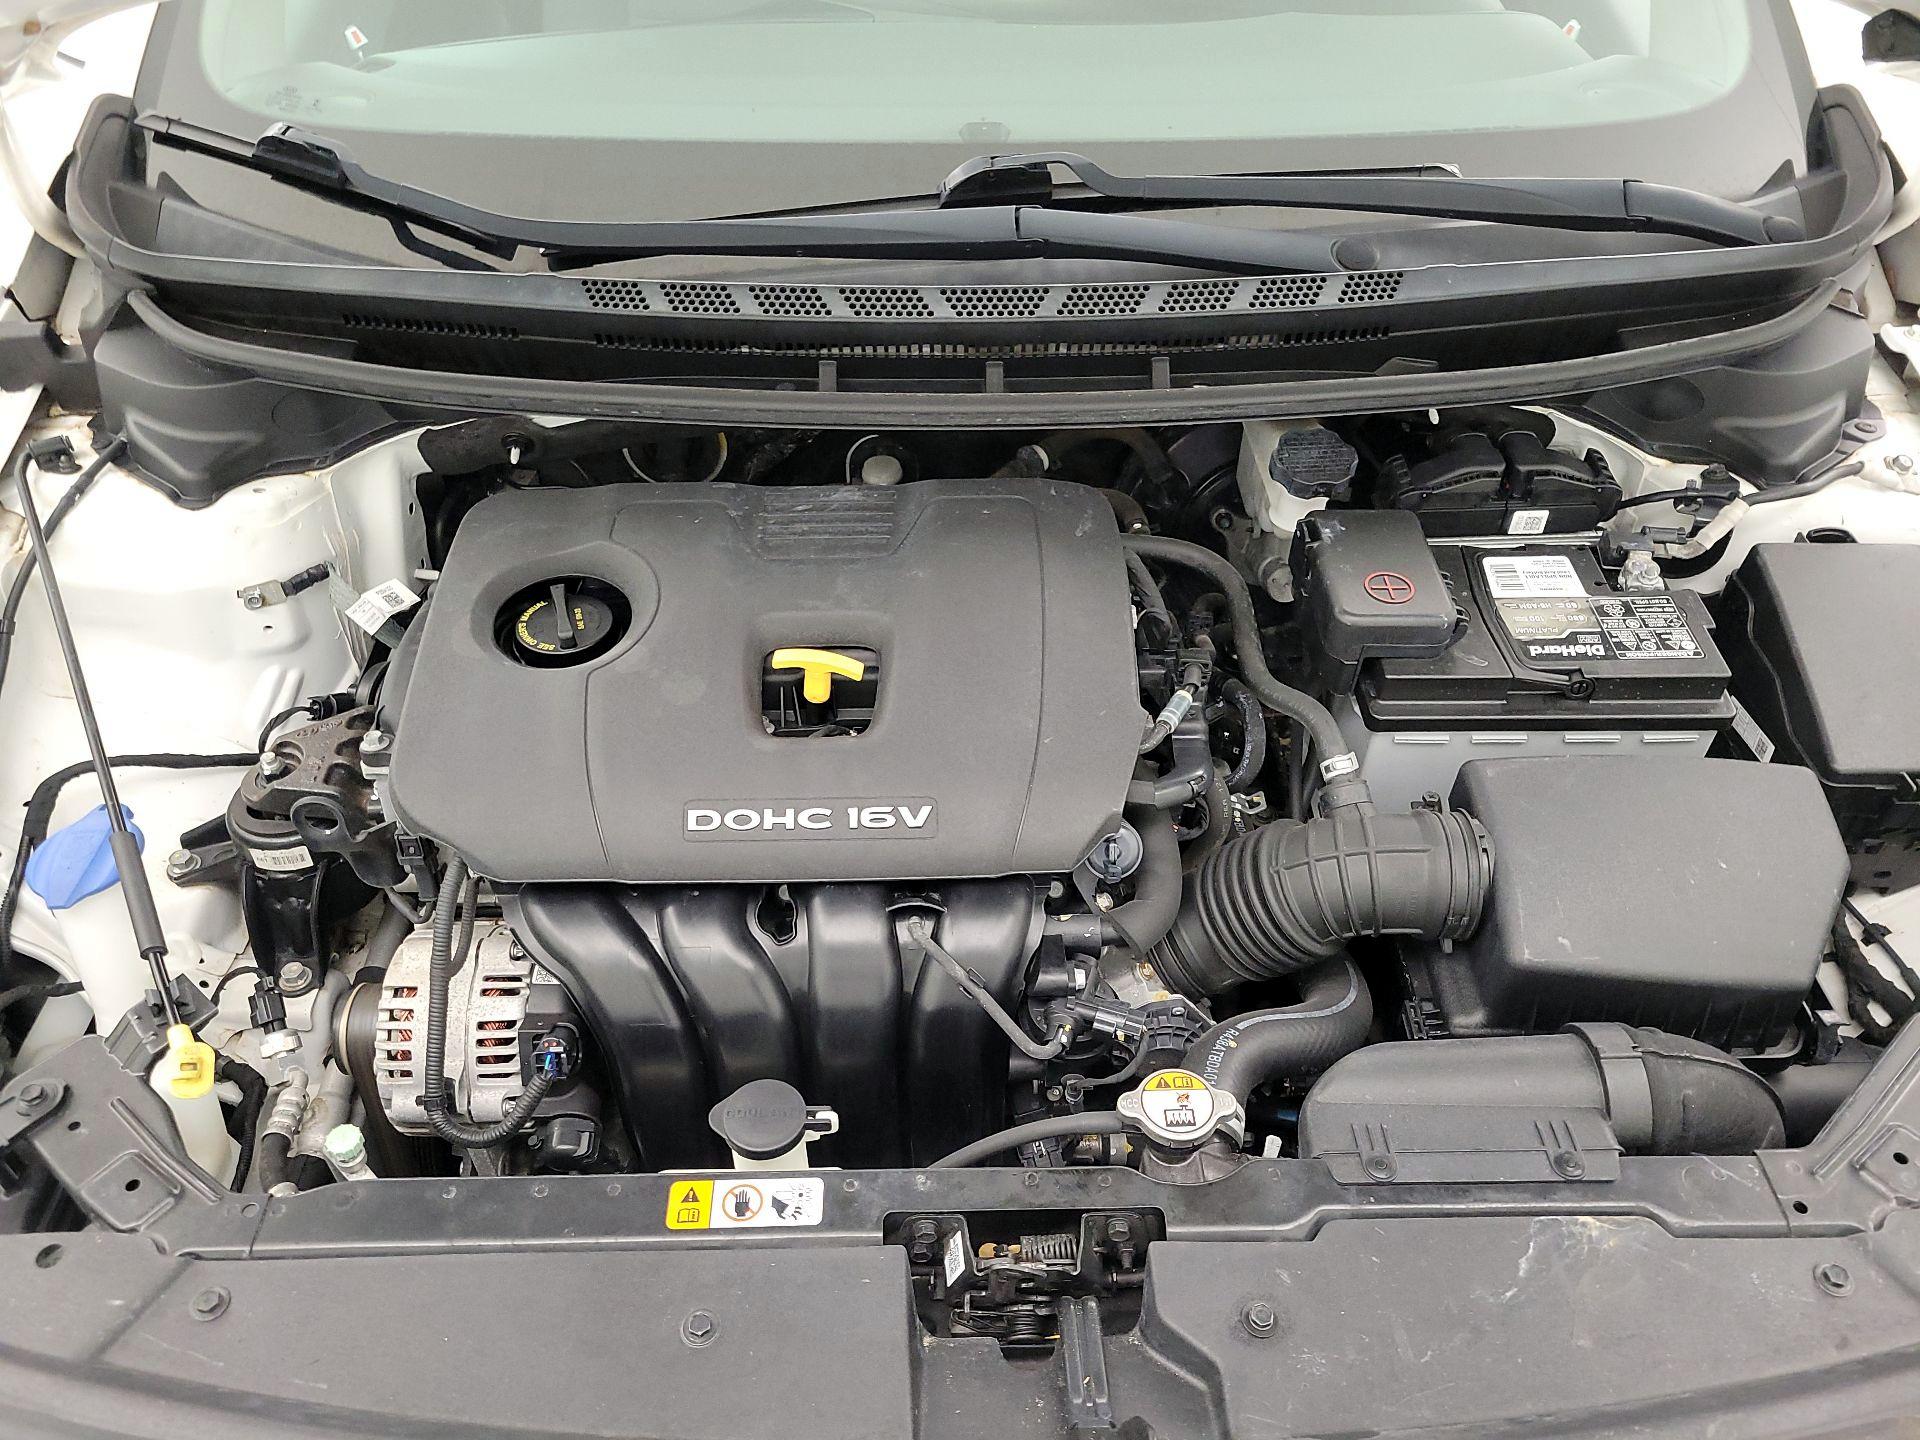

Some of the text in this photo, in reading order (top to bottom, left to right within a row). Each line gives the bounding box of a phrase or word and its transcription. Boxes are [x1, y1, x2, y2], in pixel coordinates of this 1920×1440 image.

[518, 600, 556, 651] SEE OWNER'S MANUAL
[1528, 644, 1605, 657] DieHard
[687, 805, 933, 831] DOHC 16V
